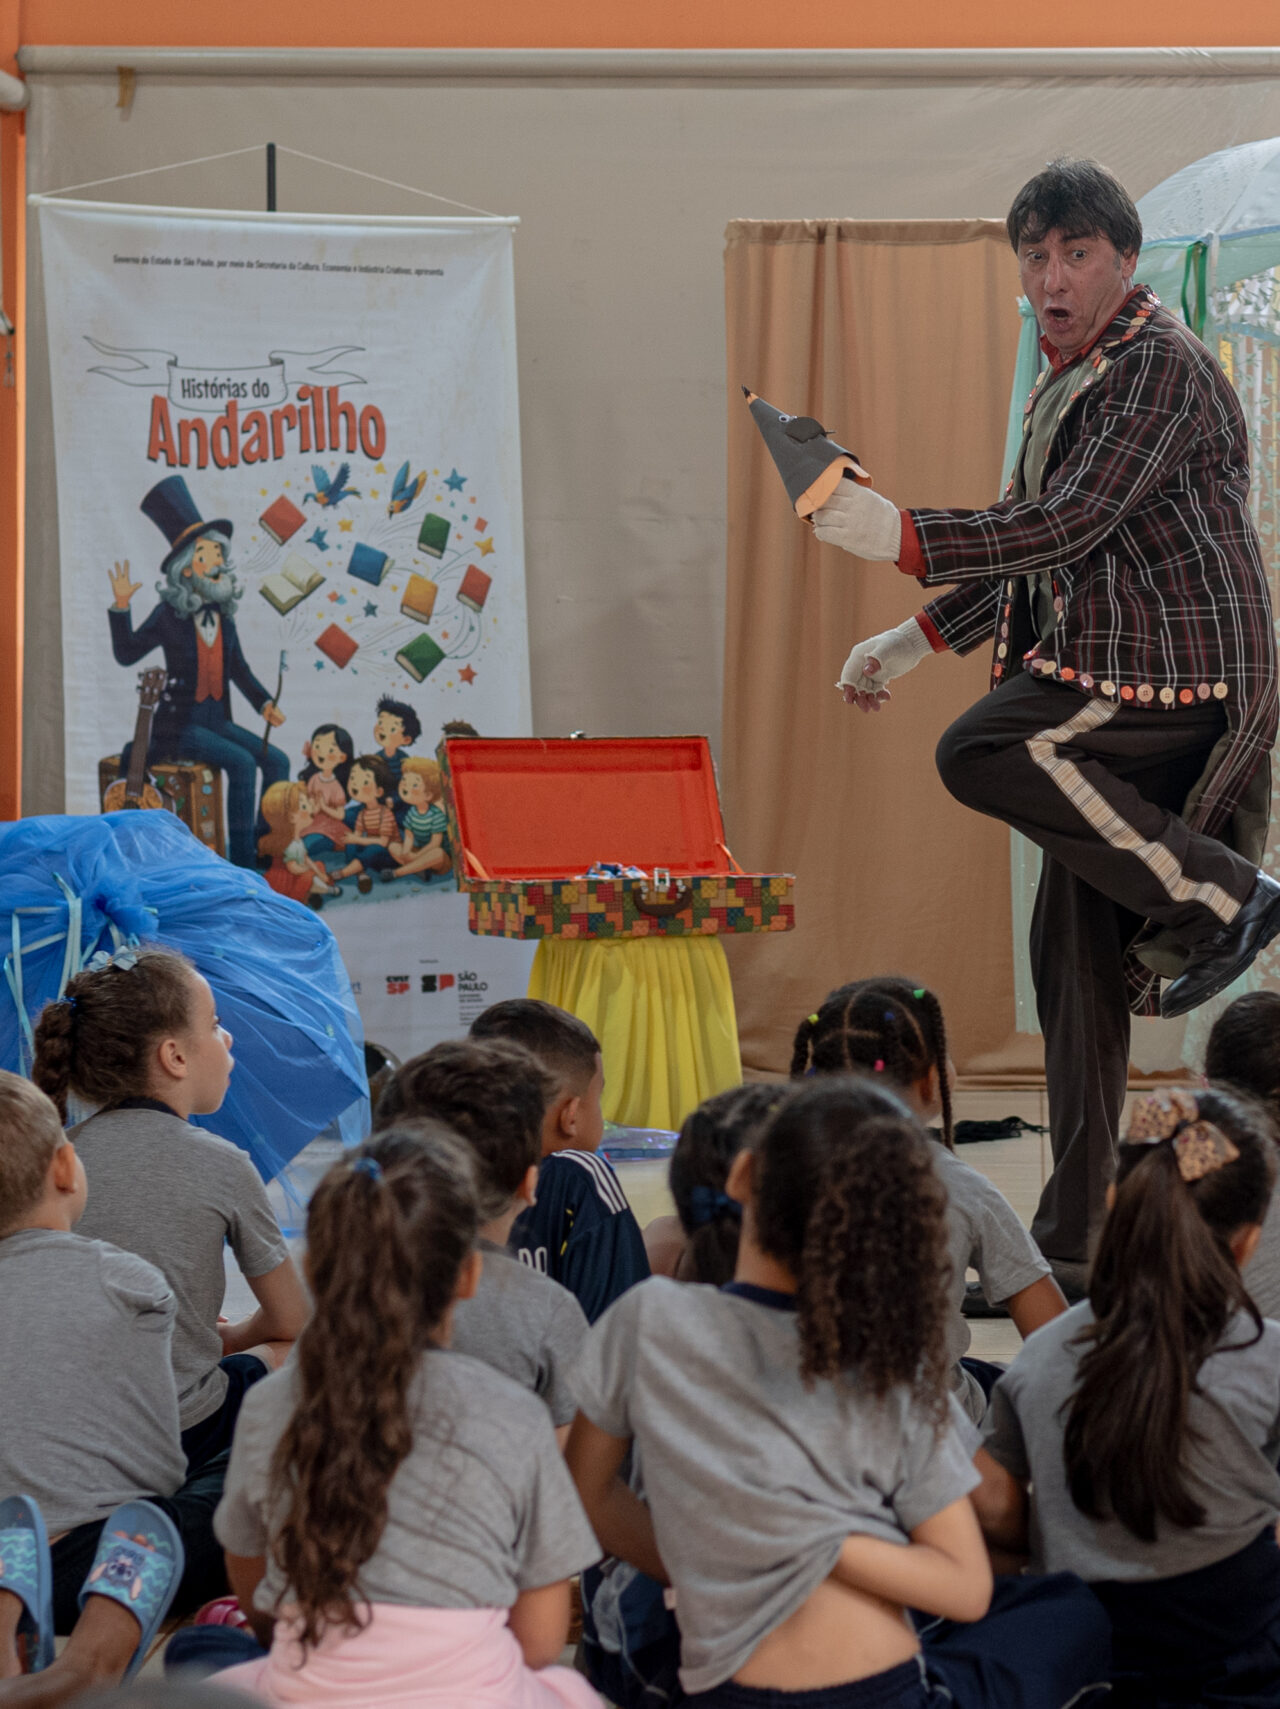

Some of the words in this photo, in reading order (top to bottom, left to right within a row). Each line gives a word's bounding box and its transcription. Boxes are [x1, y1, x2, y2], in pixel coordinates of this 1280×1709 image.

[151, 255, 172, 265] Estado
[181, 377, 247, 399] Histórias
[252, 378, 270, 398] do
[147, 384, 386, 470] Andarilho
[458, 970, 478, 982] SÃO
[458, 982, 488, 993] PAULO
